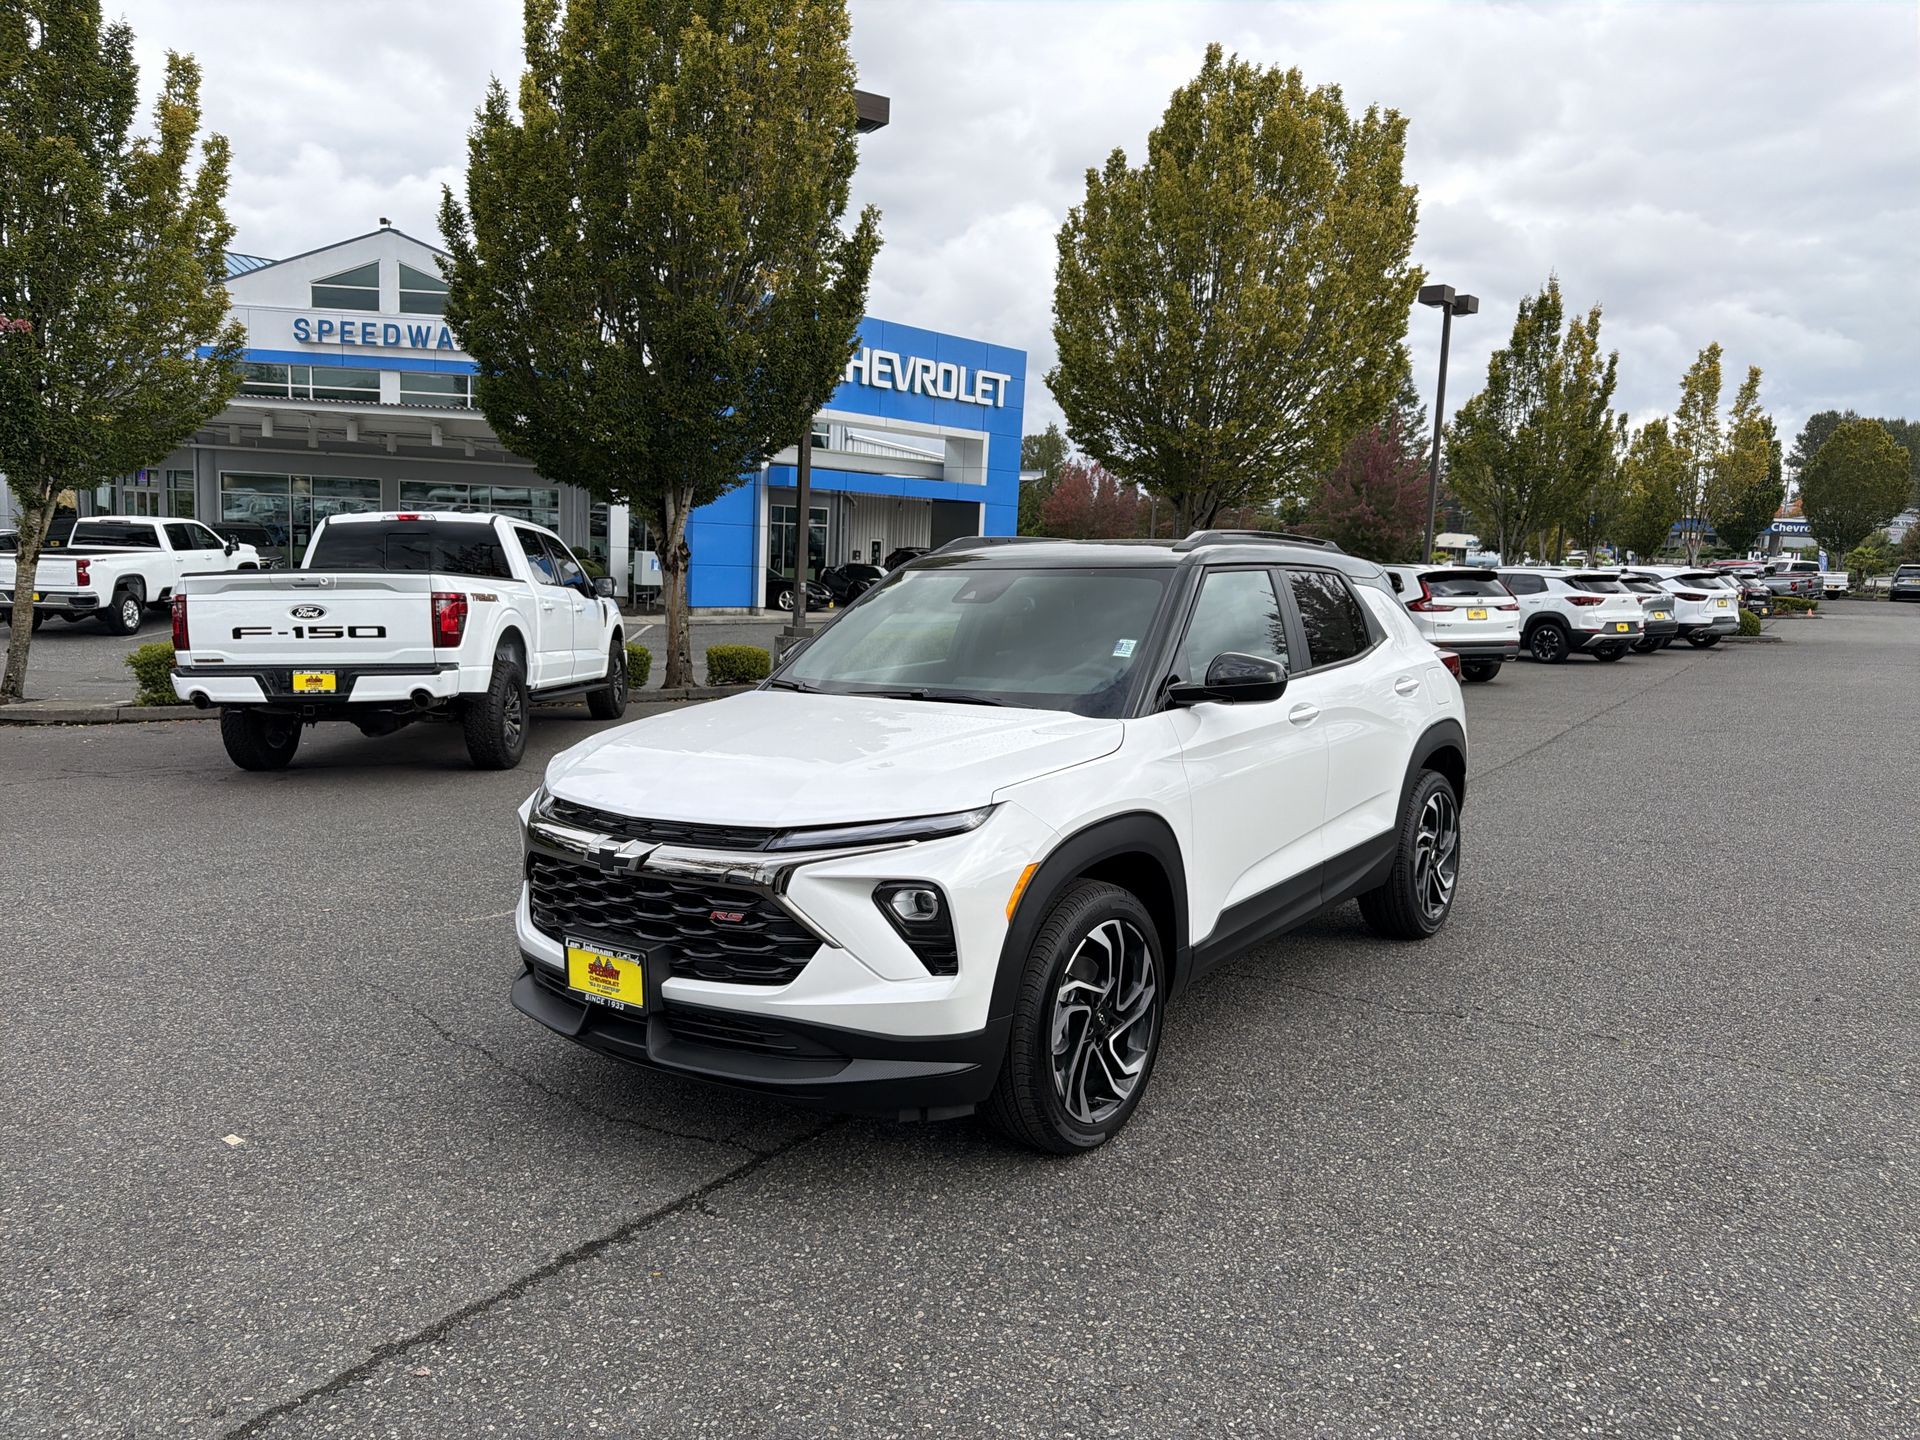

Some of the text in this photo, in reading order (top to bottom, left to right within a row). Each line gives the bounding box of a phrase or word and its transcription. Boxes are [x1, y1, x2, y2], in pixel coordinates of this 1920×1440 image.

[293, 318, 455, 351] SPEEDWA
[839, 346, 1012, 408] HEVROLET
[1770, 522, 1812, 533] Chevro
[296, 607, 320, 618] Ford
[231, 625, 387, 640] F-150
[710, 910, 745, 922] RS
[584, 993, 625, 1011] SINCE 1933
